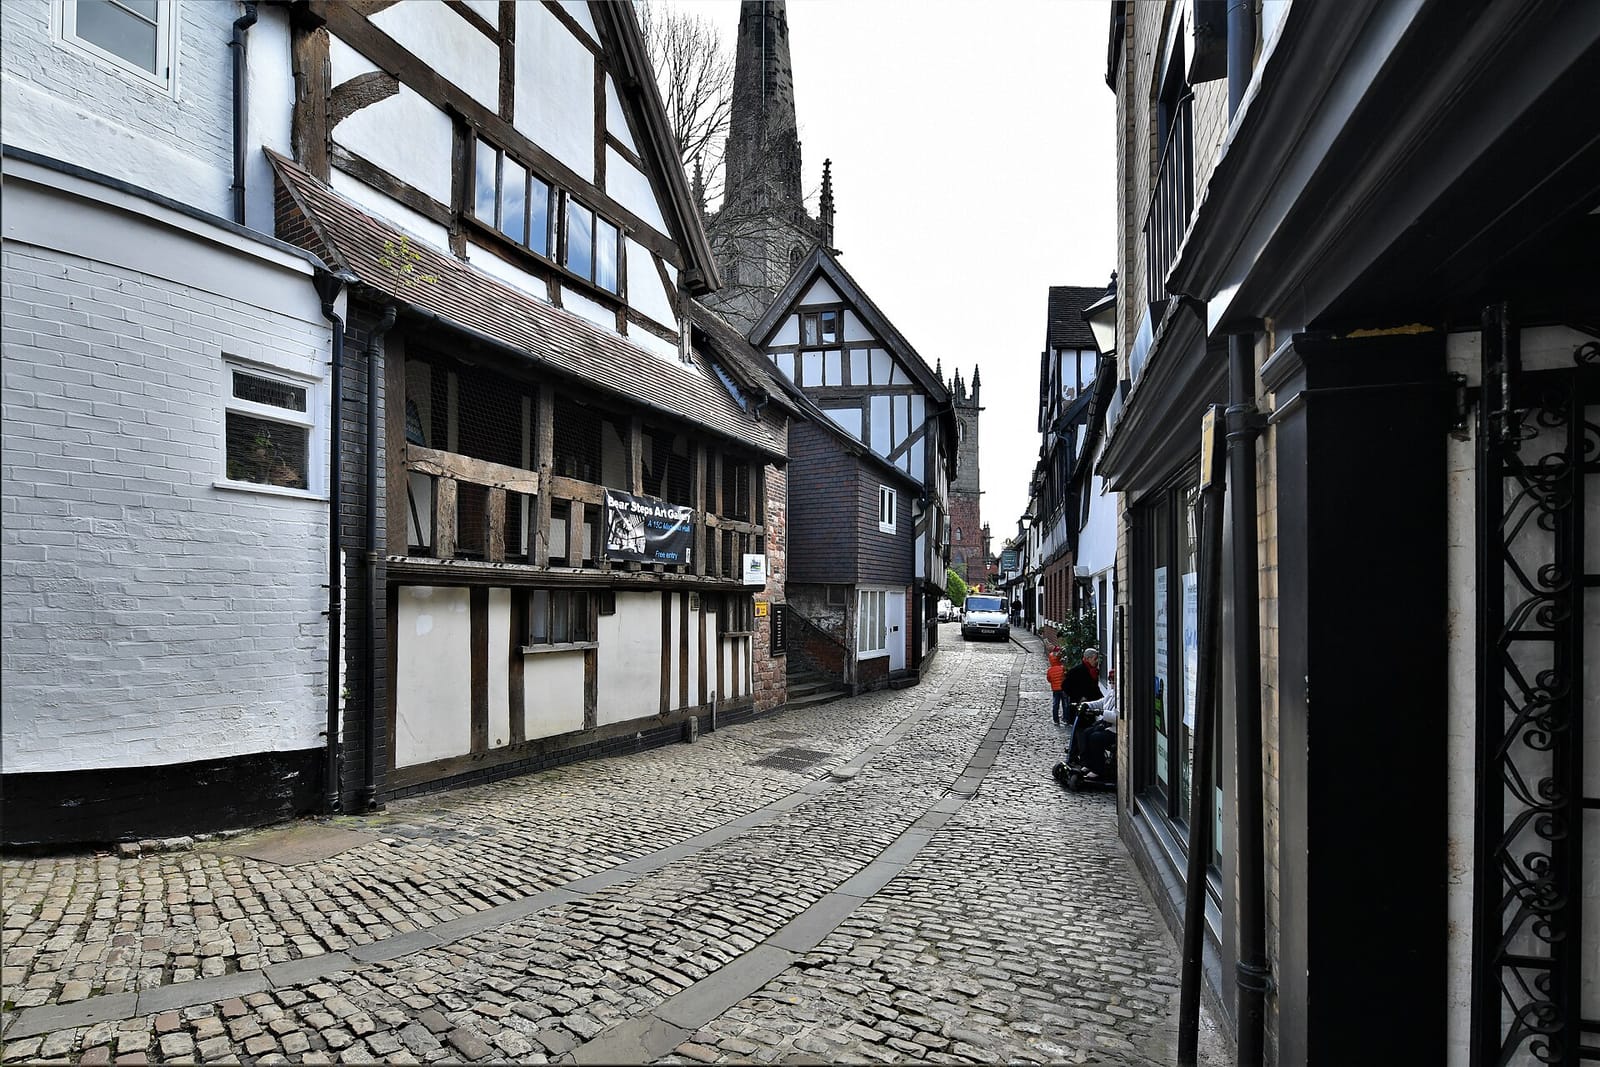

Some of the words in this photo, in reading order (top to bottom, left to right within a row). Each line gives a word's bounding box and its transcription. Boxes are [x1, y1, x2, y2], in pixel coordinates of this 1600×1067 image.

[607, 495, 629, 510] Bear
[630, 501, 653, 517] Steps
[654, 507, 668, 519] Art
[667, 509, 691, 523] Gallery
[655, 550, 666, 558] Free
[666, 552, 679, 560] entry
